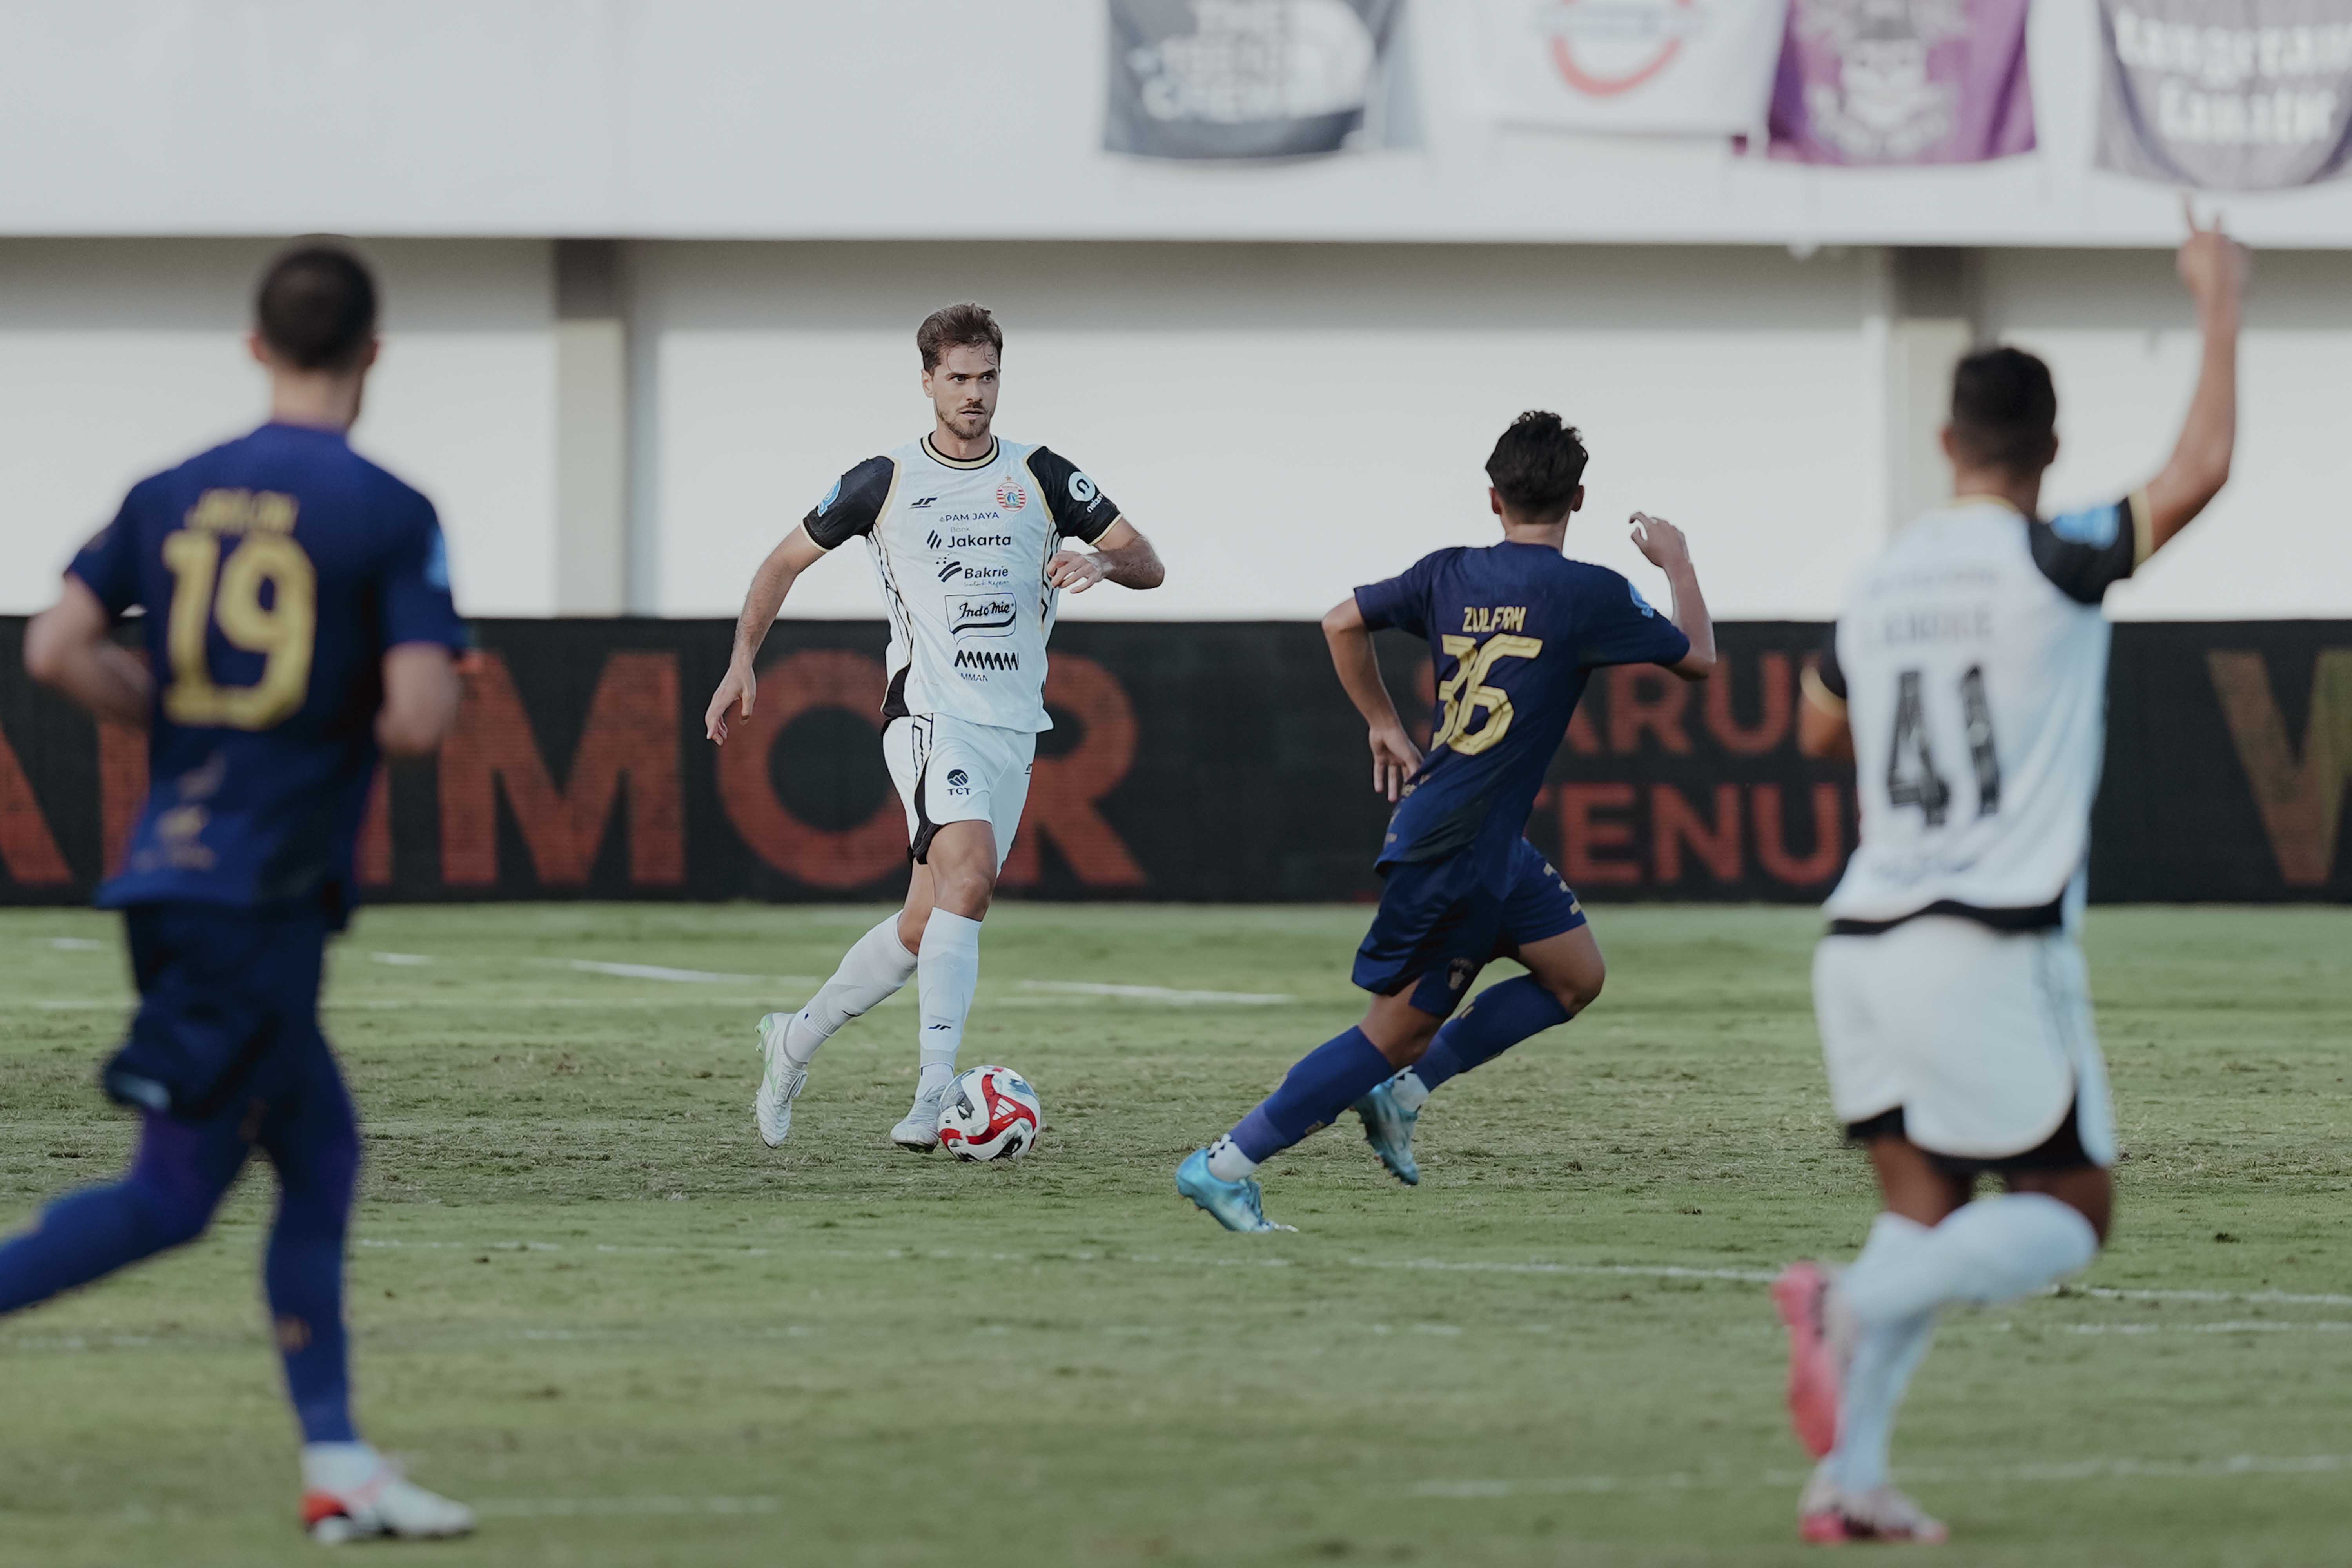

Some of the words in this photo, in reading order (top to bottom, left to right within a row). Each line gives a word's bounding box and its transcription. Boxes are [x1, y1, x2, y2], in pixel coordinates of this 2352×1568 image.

[946, 514, 969, 522] PAM
[973, 512, 1000, 521] JAYA
[947, 534, 1011, 548] Jakarta
[964, 566, 1009, 579] Bakrie
[1462, 606, 1527, 633] ZULFAN
[162, 528, 317, 732] 19
[1430, 632, 1543, 756] 36
[1886, 663, 2000, 828] 41
[947, 787, 971, 796] TCT
